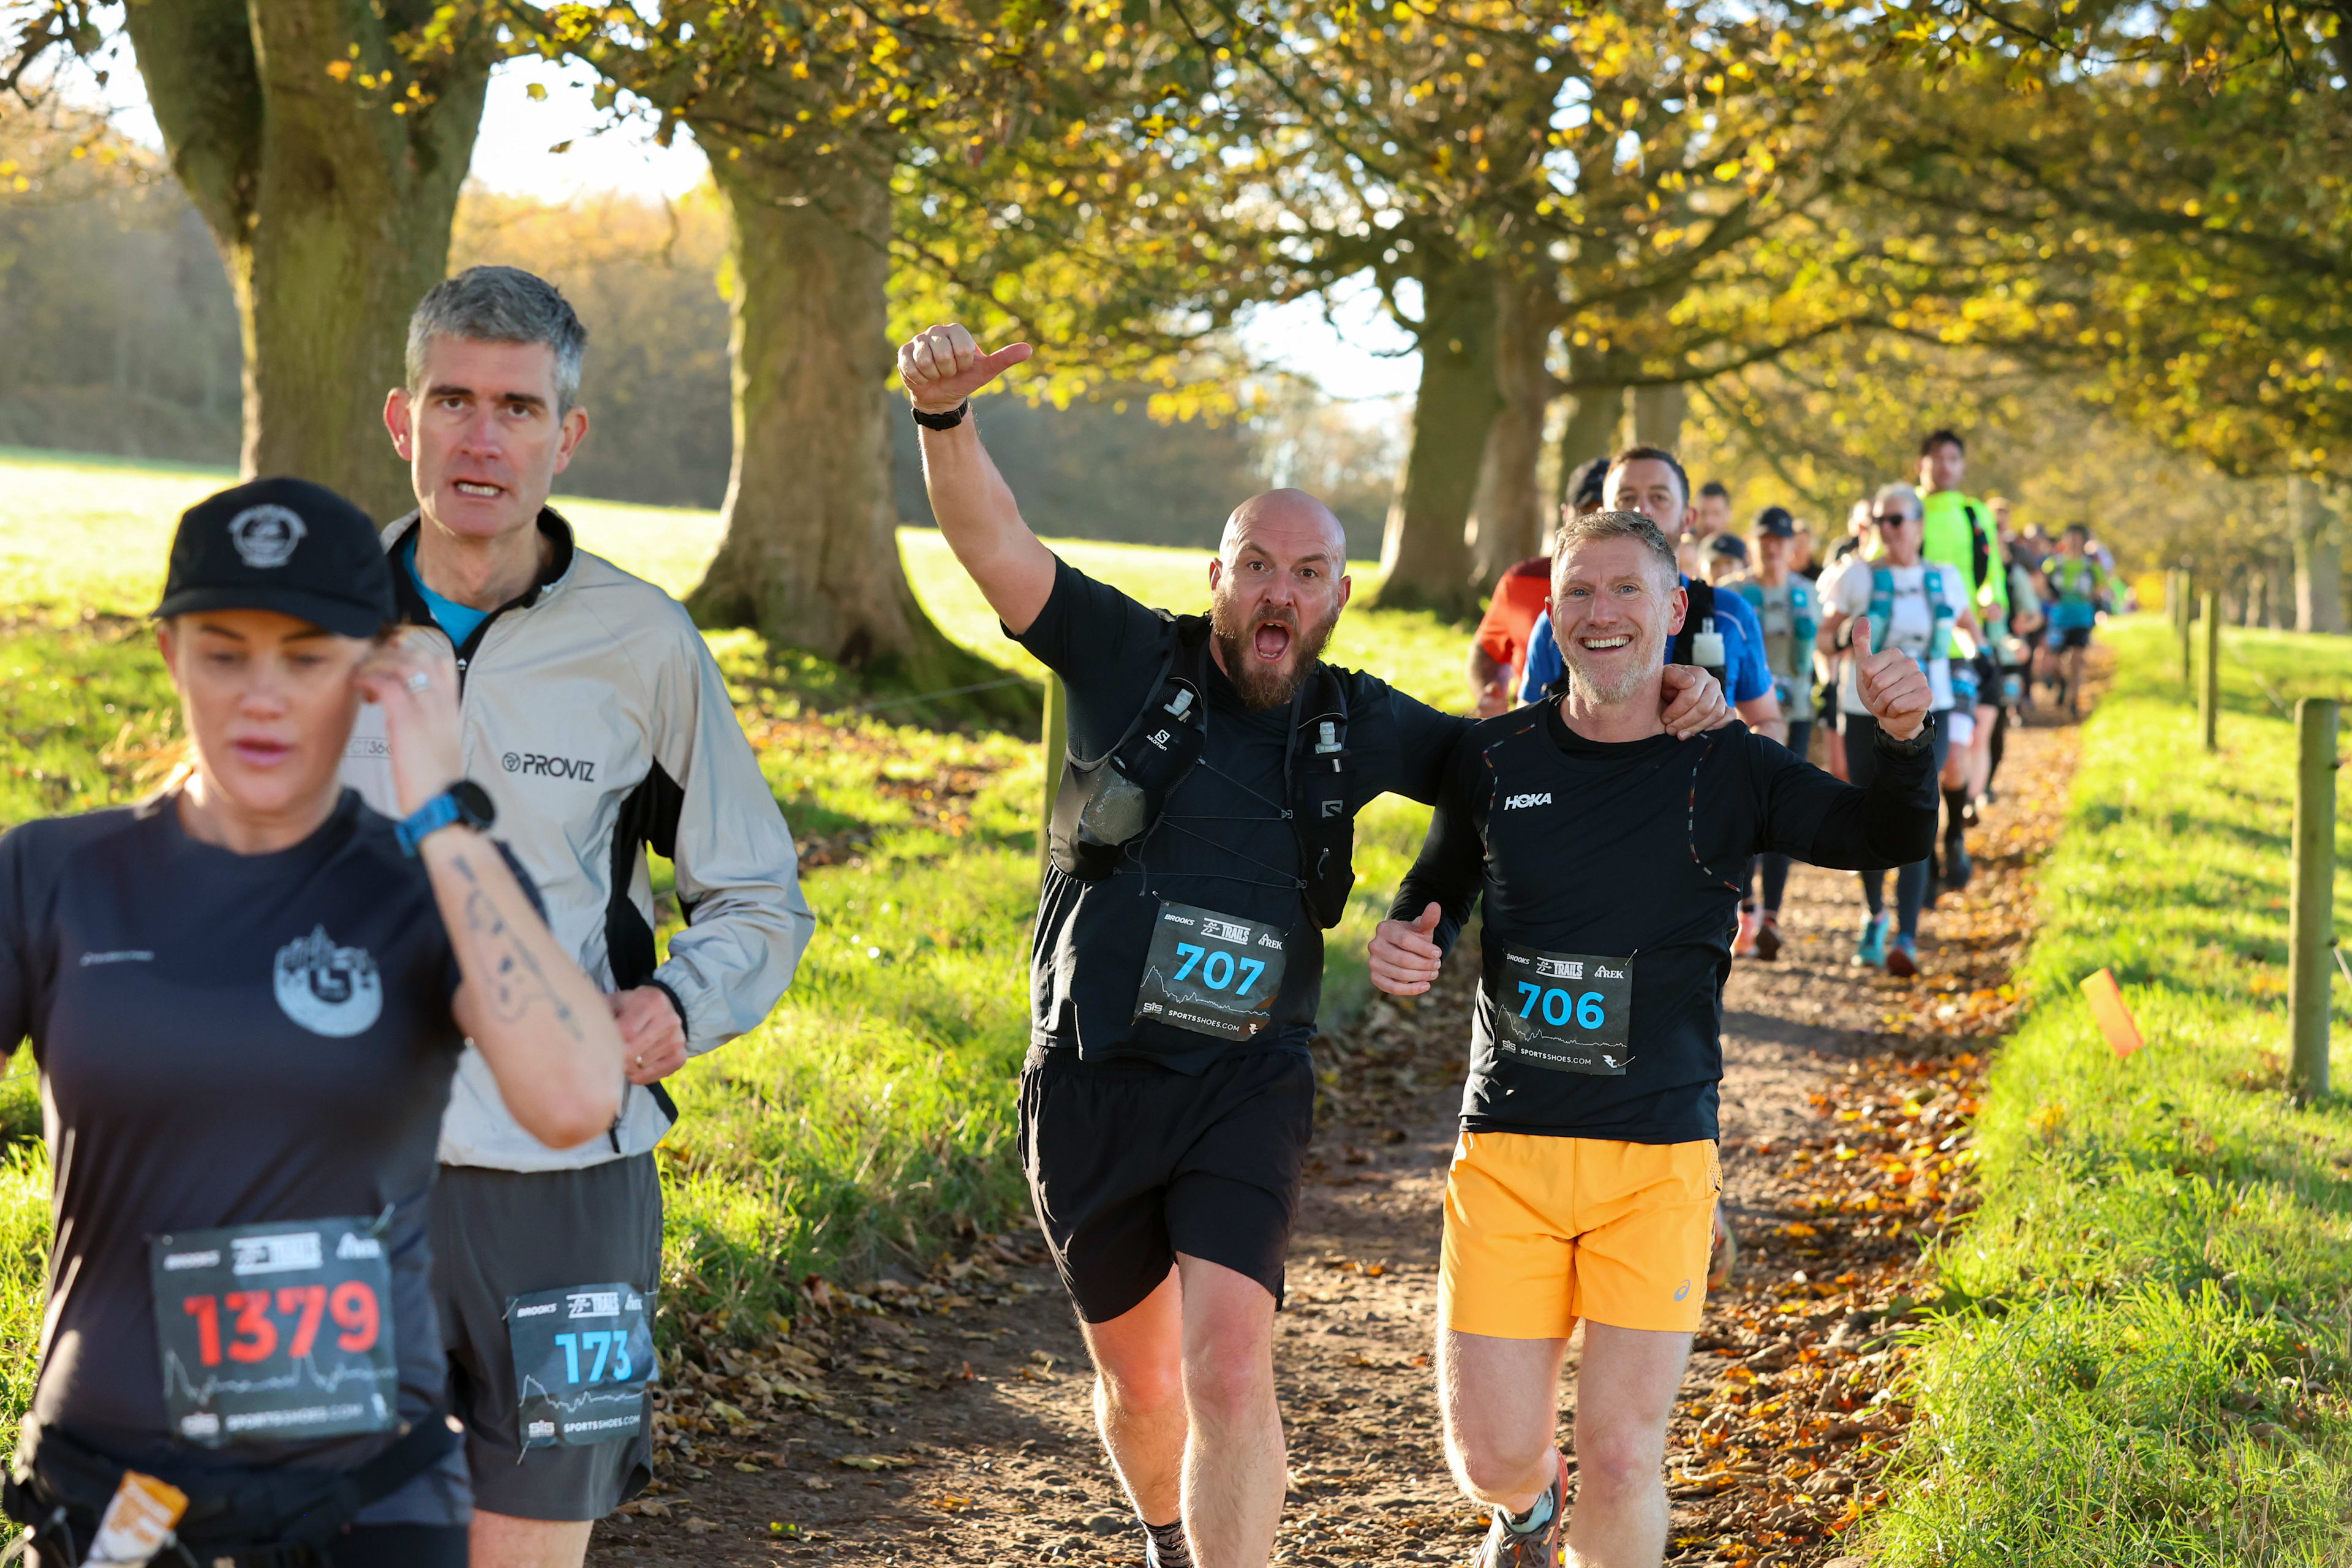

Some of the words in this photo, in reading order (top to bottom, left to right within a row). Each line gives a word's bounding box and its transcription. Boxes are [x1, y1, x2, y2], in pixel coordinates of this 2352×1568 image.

[522, 753, 595, 782] PROVIZ
[1504, 793, 1552, 810] HOKA
[1164, 913, 1195, 926] BROOKS
[1221, 924, 1250, 942] TRAILS
[1261, 937, 1283, 950] TREK
[1173, 941, 1265, 996] 707
[1554, 962, 1583, 977] TRAILS
[1597, 969, 1624, 979] TREK
[1518, 981, 1605, 1030] 706
[1168, 1009, 1240, 1032] SPORTSSHOES.COM
[1520, 1048, 1592, 1065] SPORTSSHOES.COM
[184, 1280, 380, 1367] 1379
[554, 1330, 633, 1384] 173
